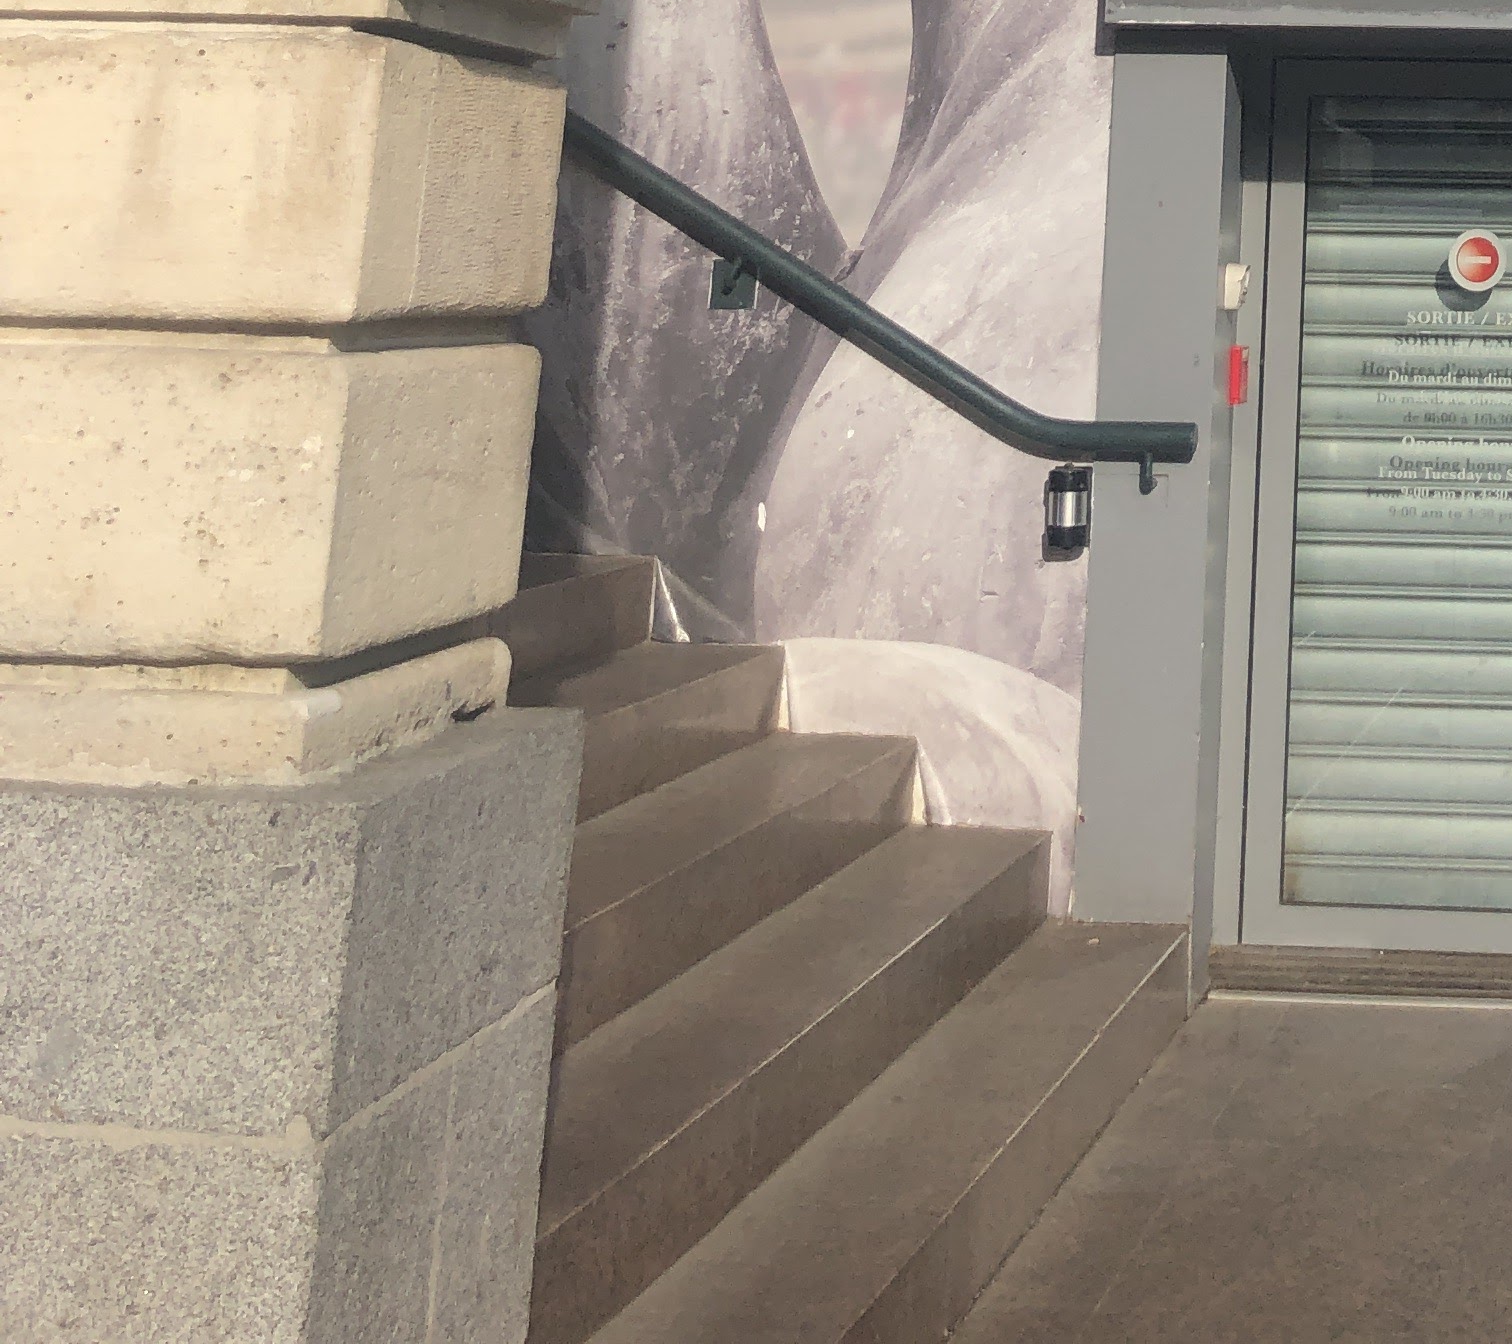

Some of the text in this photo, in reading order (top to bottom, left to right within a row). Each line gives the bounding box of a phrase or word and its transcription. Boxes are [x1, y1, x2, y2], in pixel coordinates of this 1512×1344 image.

[1406, 311, 1476, 326] SORTIE
[1388, 370, 1410, 383] Du
[1413, 372, 1457, 385] mardi
[1461, 375, 1481, 386] au
[1377, 466, 1418, 480] From
[1422, 467, 1484, 483] Tuesday
[1487, 471, 1503, 481] to
